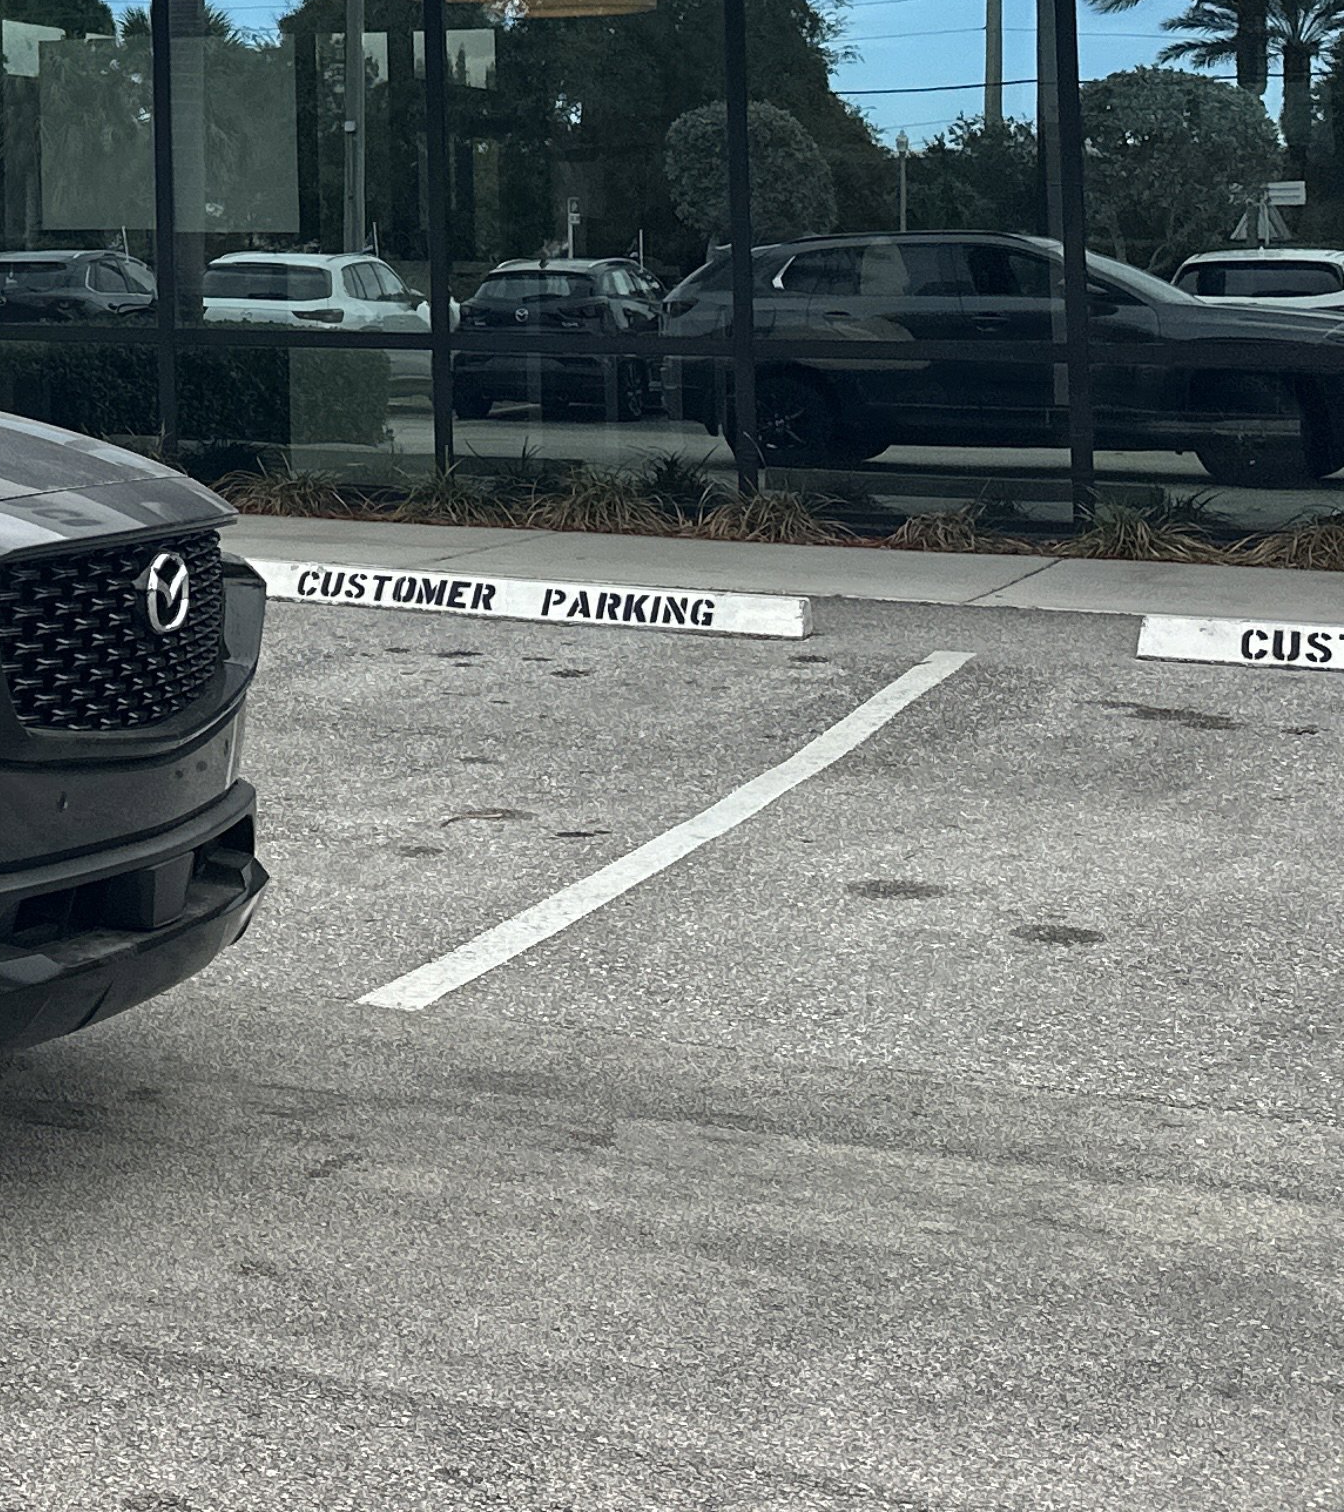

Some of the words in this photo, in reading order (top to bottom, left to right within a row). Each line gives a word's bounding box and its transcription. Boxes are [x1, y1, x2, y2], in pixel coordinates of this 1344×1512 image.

[297, 570, 496, 611] CUSTOMER
[540, 589, 715, 627] PARKING
[1241, 629, 1344, 663] CUS
